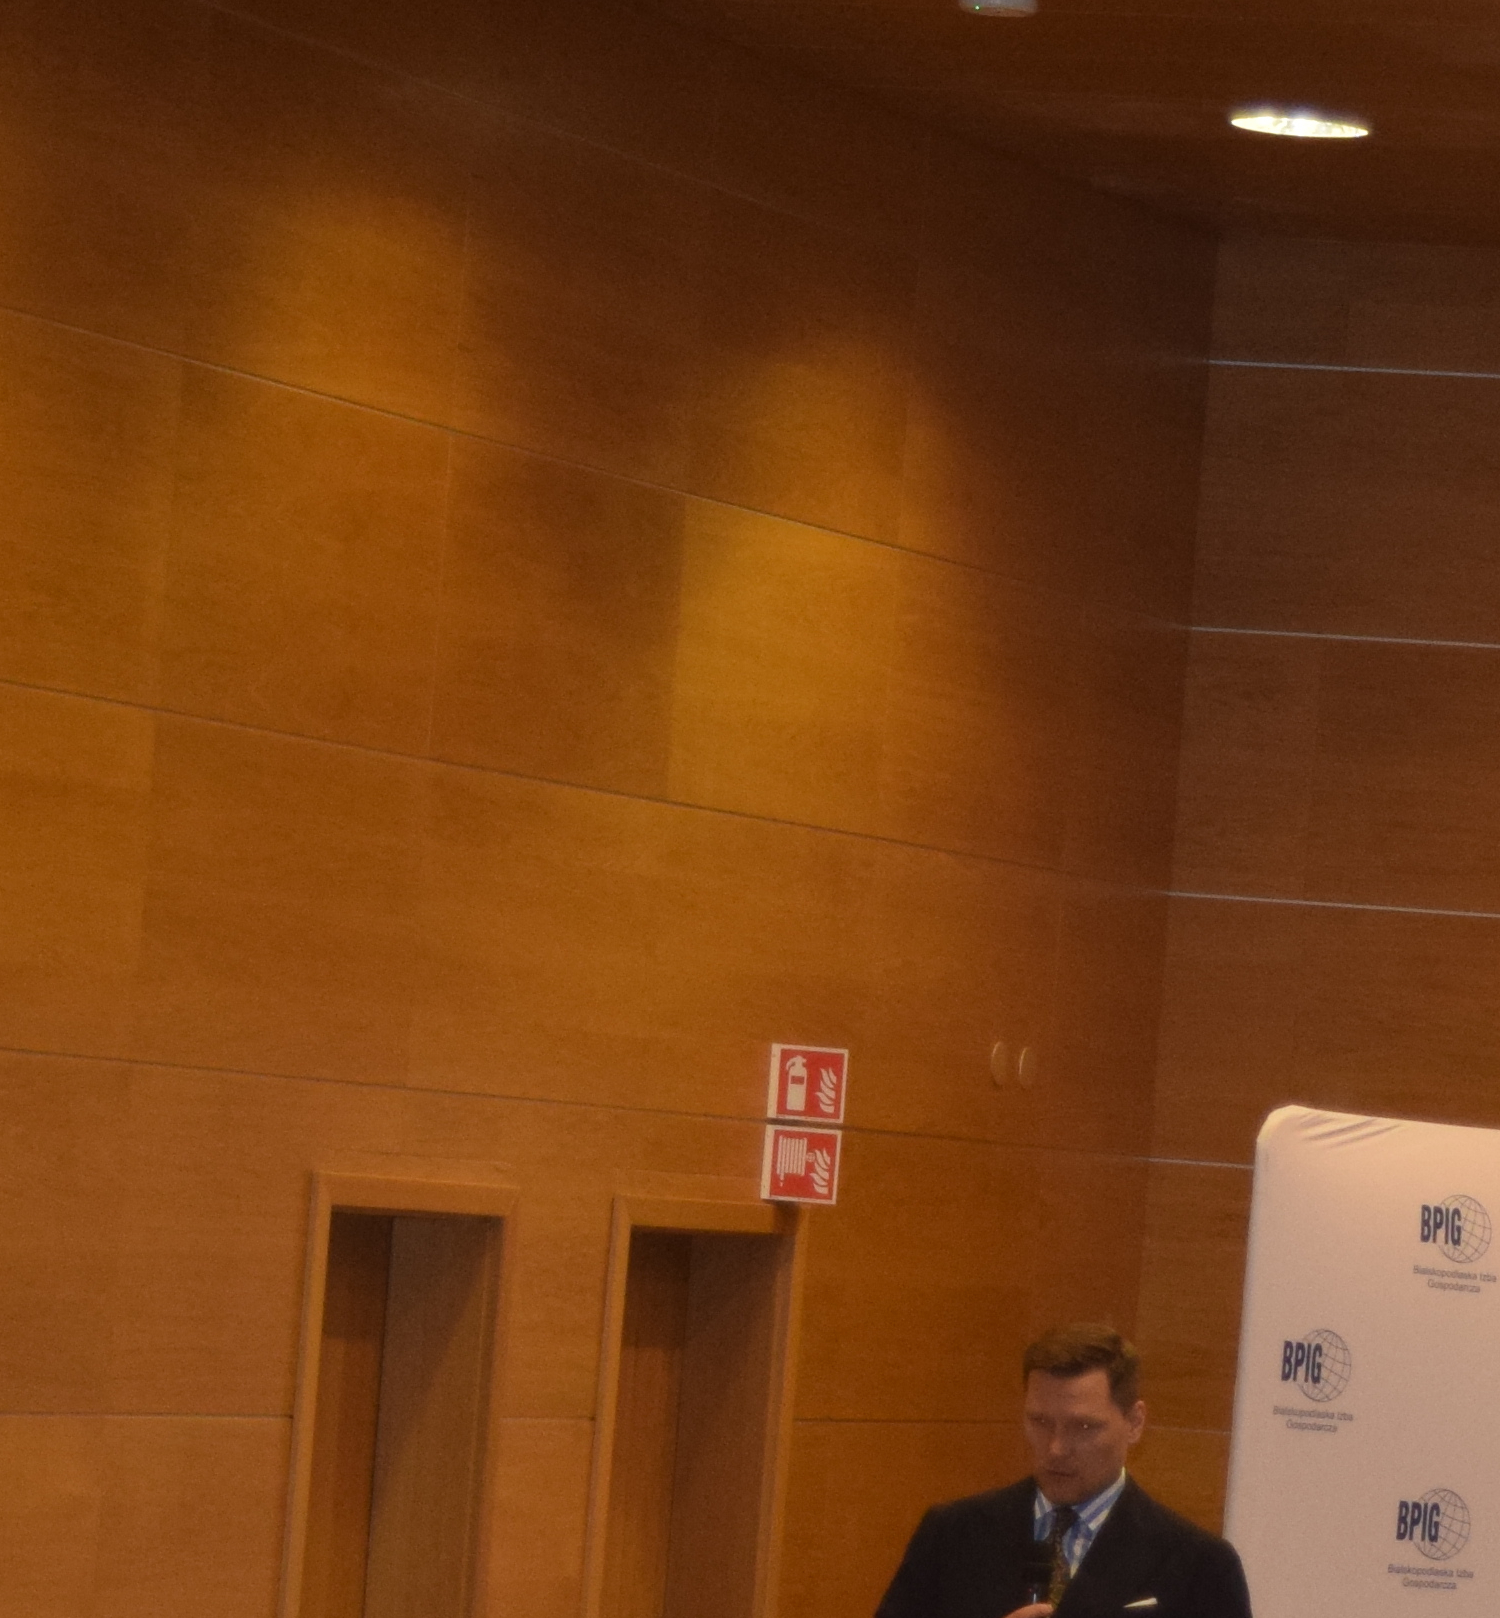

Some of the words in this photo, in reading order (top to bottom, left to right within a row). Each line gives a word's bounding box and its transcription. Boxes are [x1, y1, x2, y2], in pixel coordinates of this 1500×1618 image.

[1420, 1204, 1463, 1247] BPIG
[1281, 1340, 1323, 1384] BPIG
[1395, 1500, 1440, 1543] BPIG
